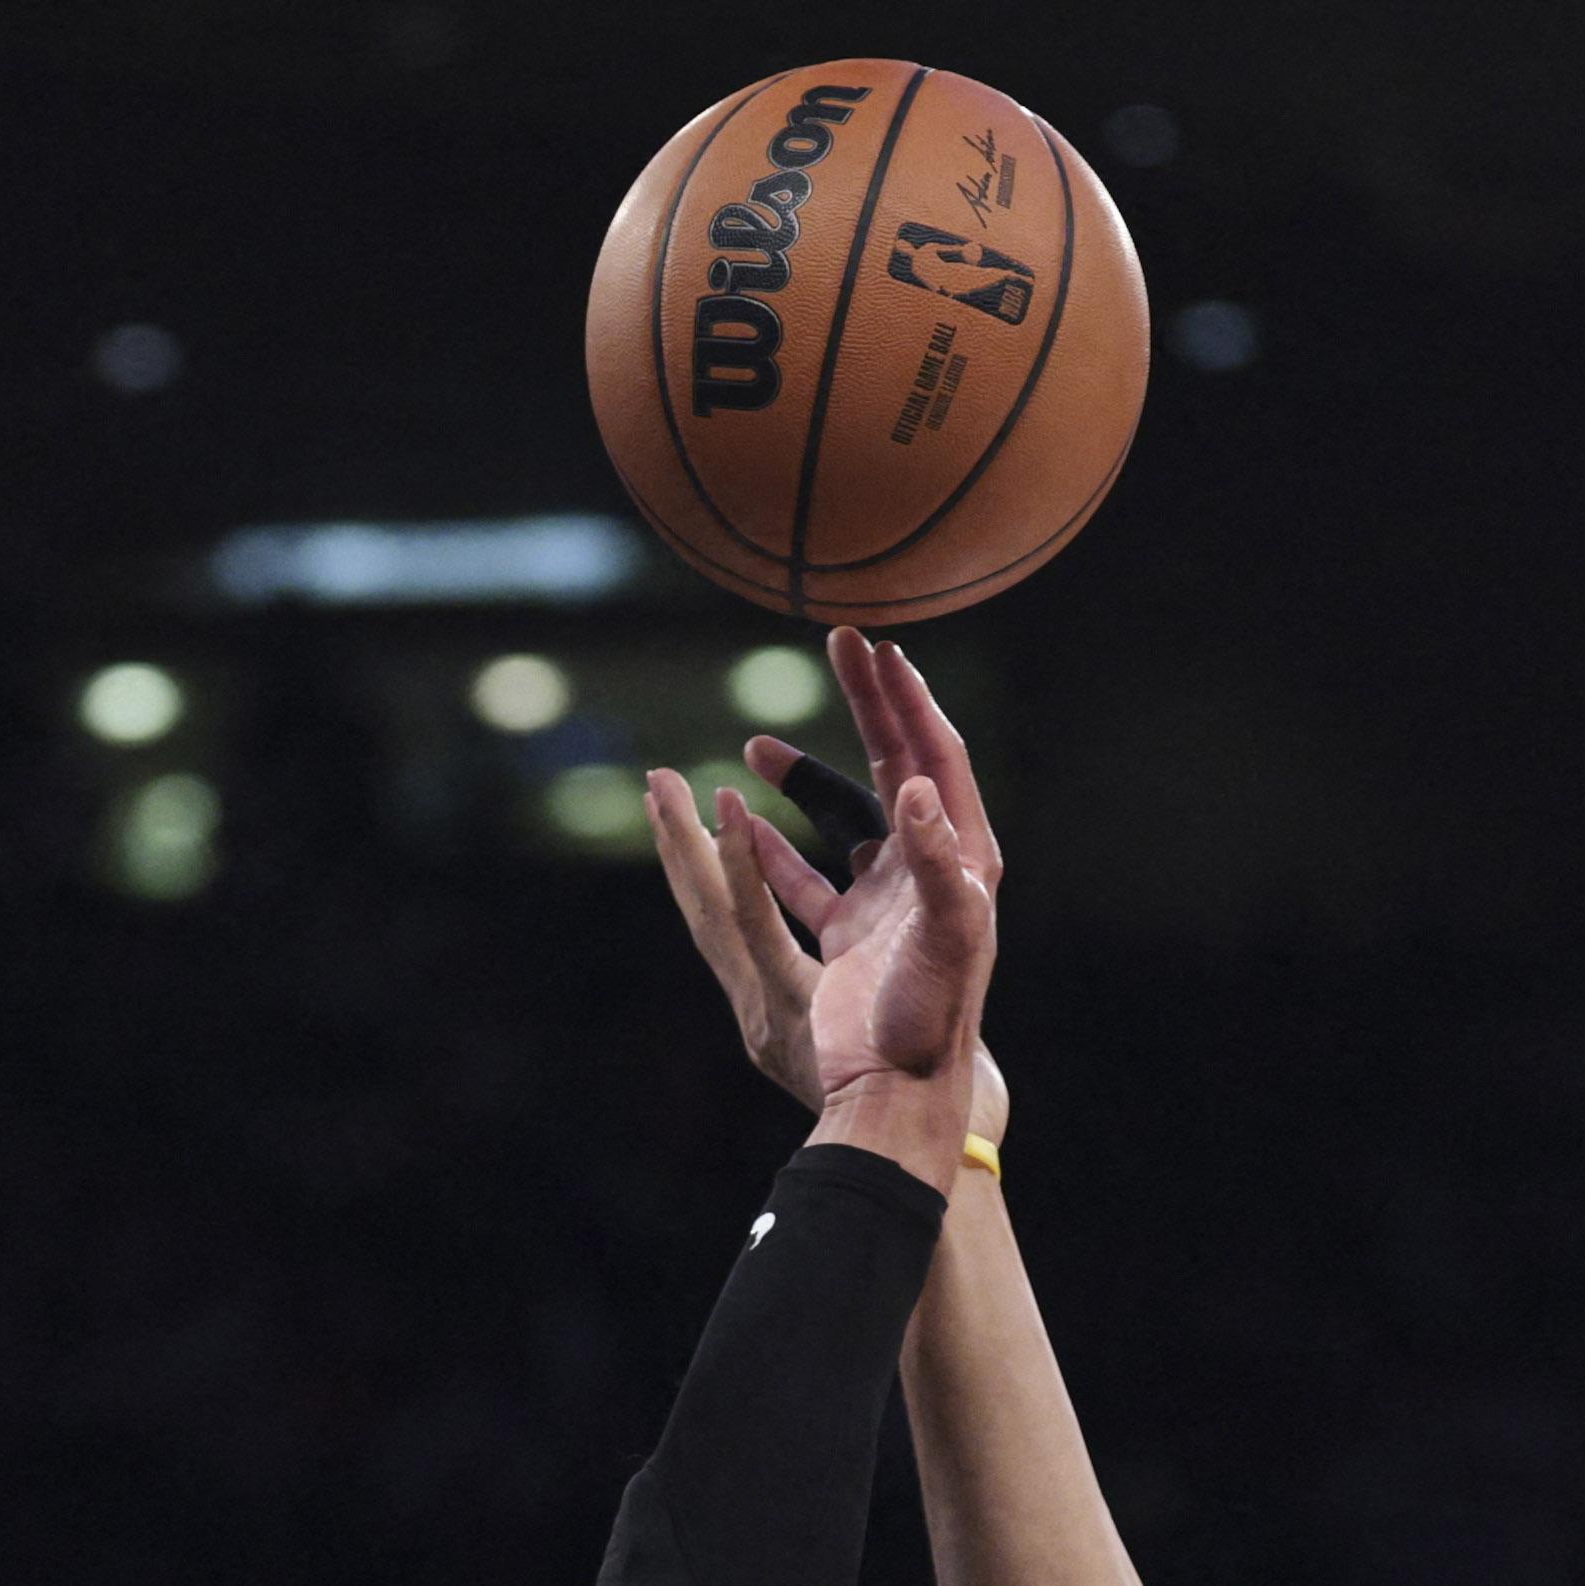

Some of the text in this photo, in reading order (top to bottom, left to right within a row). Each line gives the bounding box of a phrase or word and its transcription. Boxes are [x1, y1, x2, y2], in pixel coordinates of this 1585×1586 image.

[693, 84, 873, 418] Wilson
[891, 321, 957, 445] OFFICIAL GAME BALL
